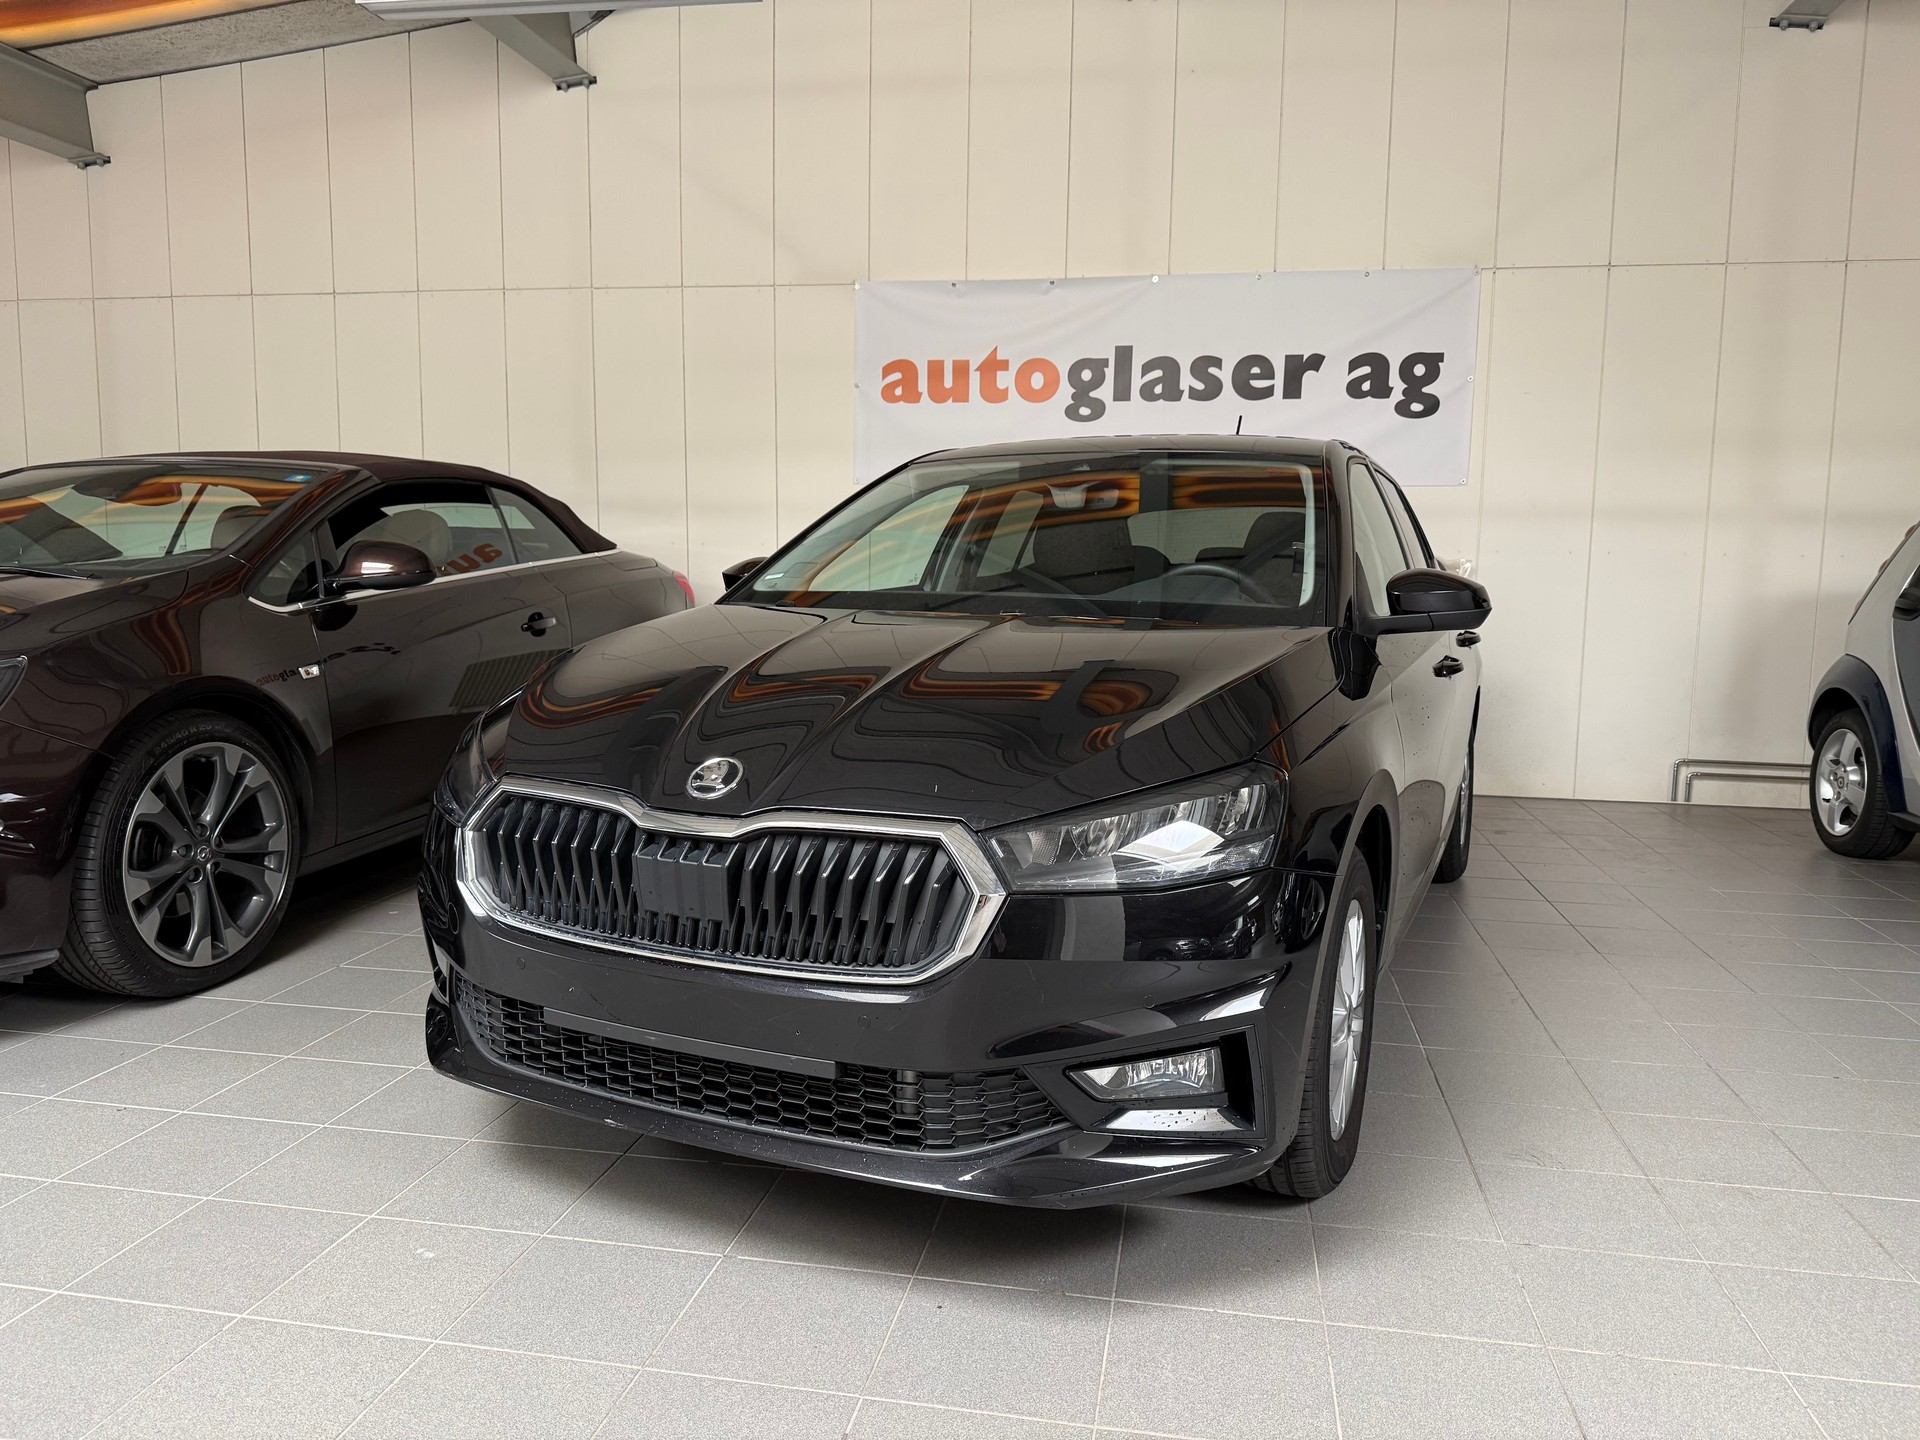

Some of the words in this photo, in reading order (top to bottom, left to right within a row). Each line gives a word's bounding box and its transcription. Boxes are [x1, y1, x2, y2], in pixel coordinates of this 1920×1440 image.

[880, 345, 1325, 422] autoglaser
[1345, 351, 1444, 419] ag
[256, 667, 298, 687] autogla
